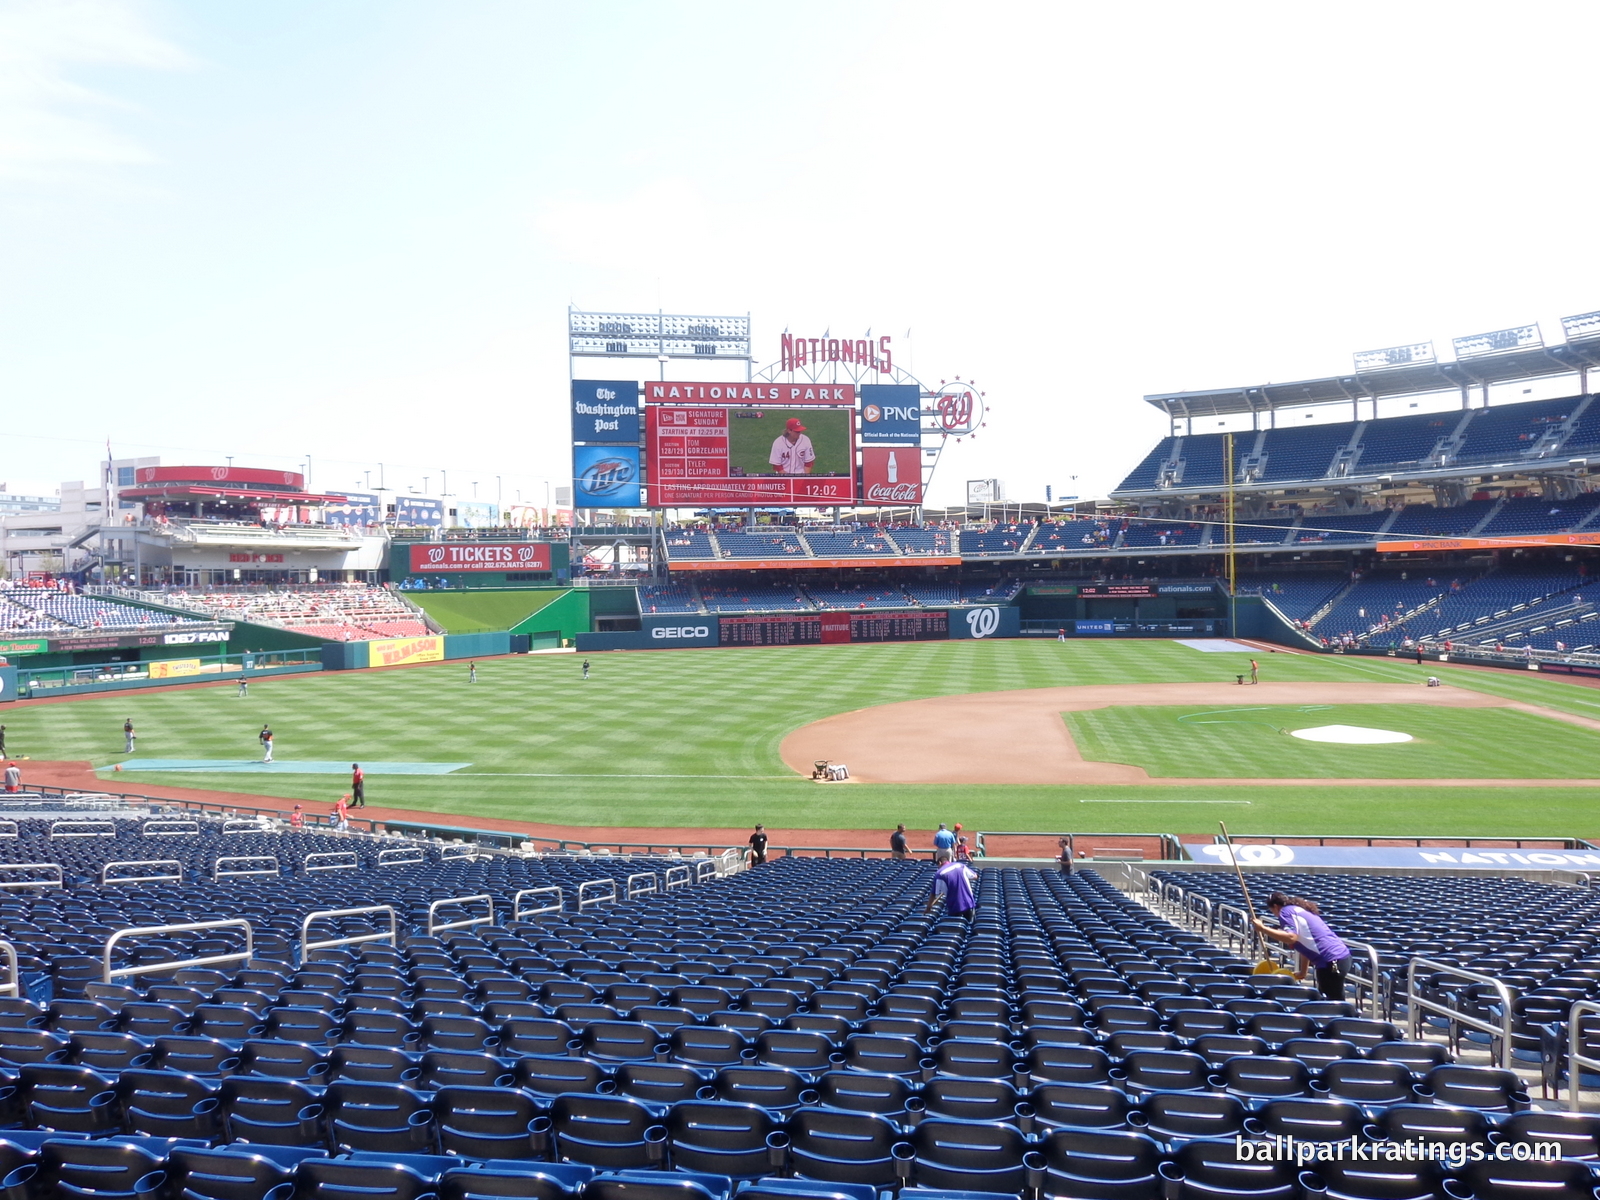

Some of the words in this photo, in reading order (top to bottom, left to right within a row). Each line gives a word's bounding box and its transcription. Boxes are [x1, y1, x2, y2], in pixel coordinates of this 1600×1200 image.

[781, 333, 891, 374] NATIONALS
[596, 388, 616, 401] The
[653, 386, 779, 399] NATIONALS
[791, 388, 844, 400] PARK
[576, 401, 637, 417] Washington
[688, 410, 724, 418] SIGNATURE
[882, 406, 919, 421] PNC
[594, 419, 619, 433] Post
[693, 418, 719, 426] SUNDAY
[806, 485, 837, 496] 12:02
[867, 483, 919, 501] Coca-Cola
[449, 547, 513, 561] TICKETS
[199, 631, 229, 642] FAN
[651, 626, 709, 639] GEICO
[139, 636, 157, 644] 12:02
